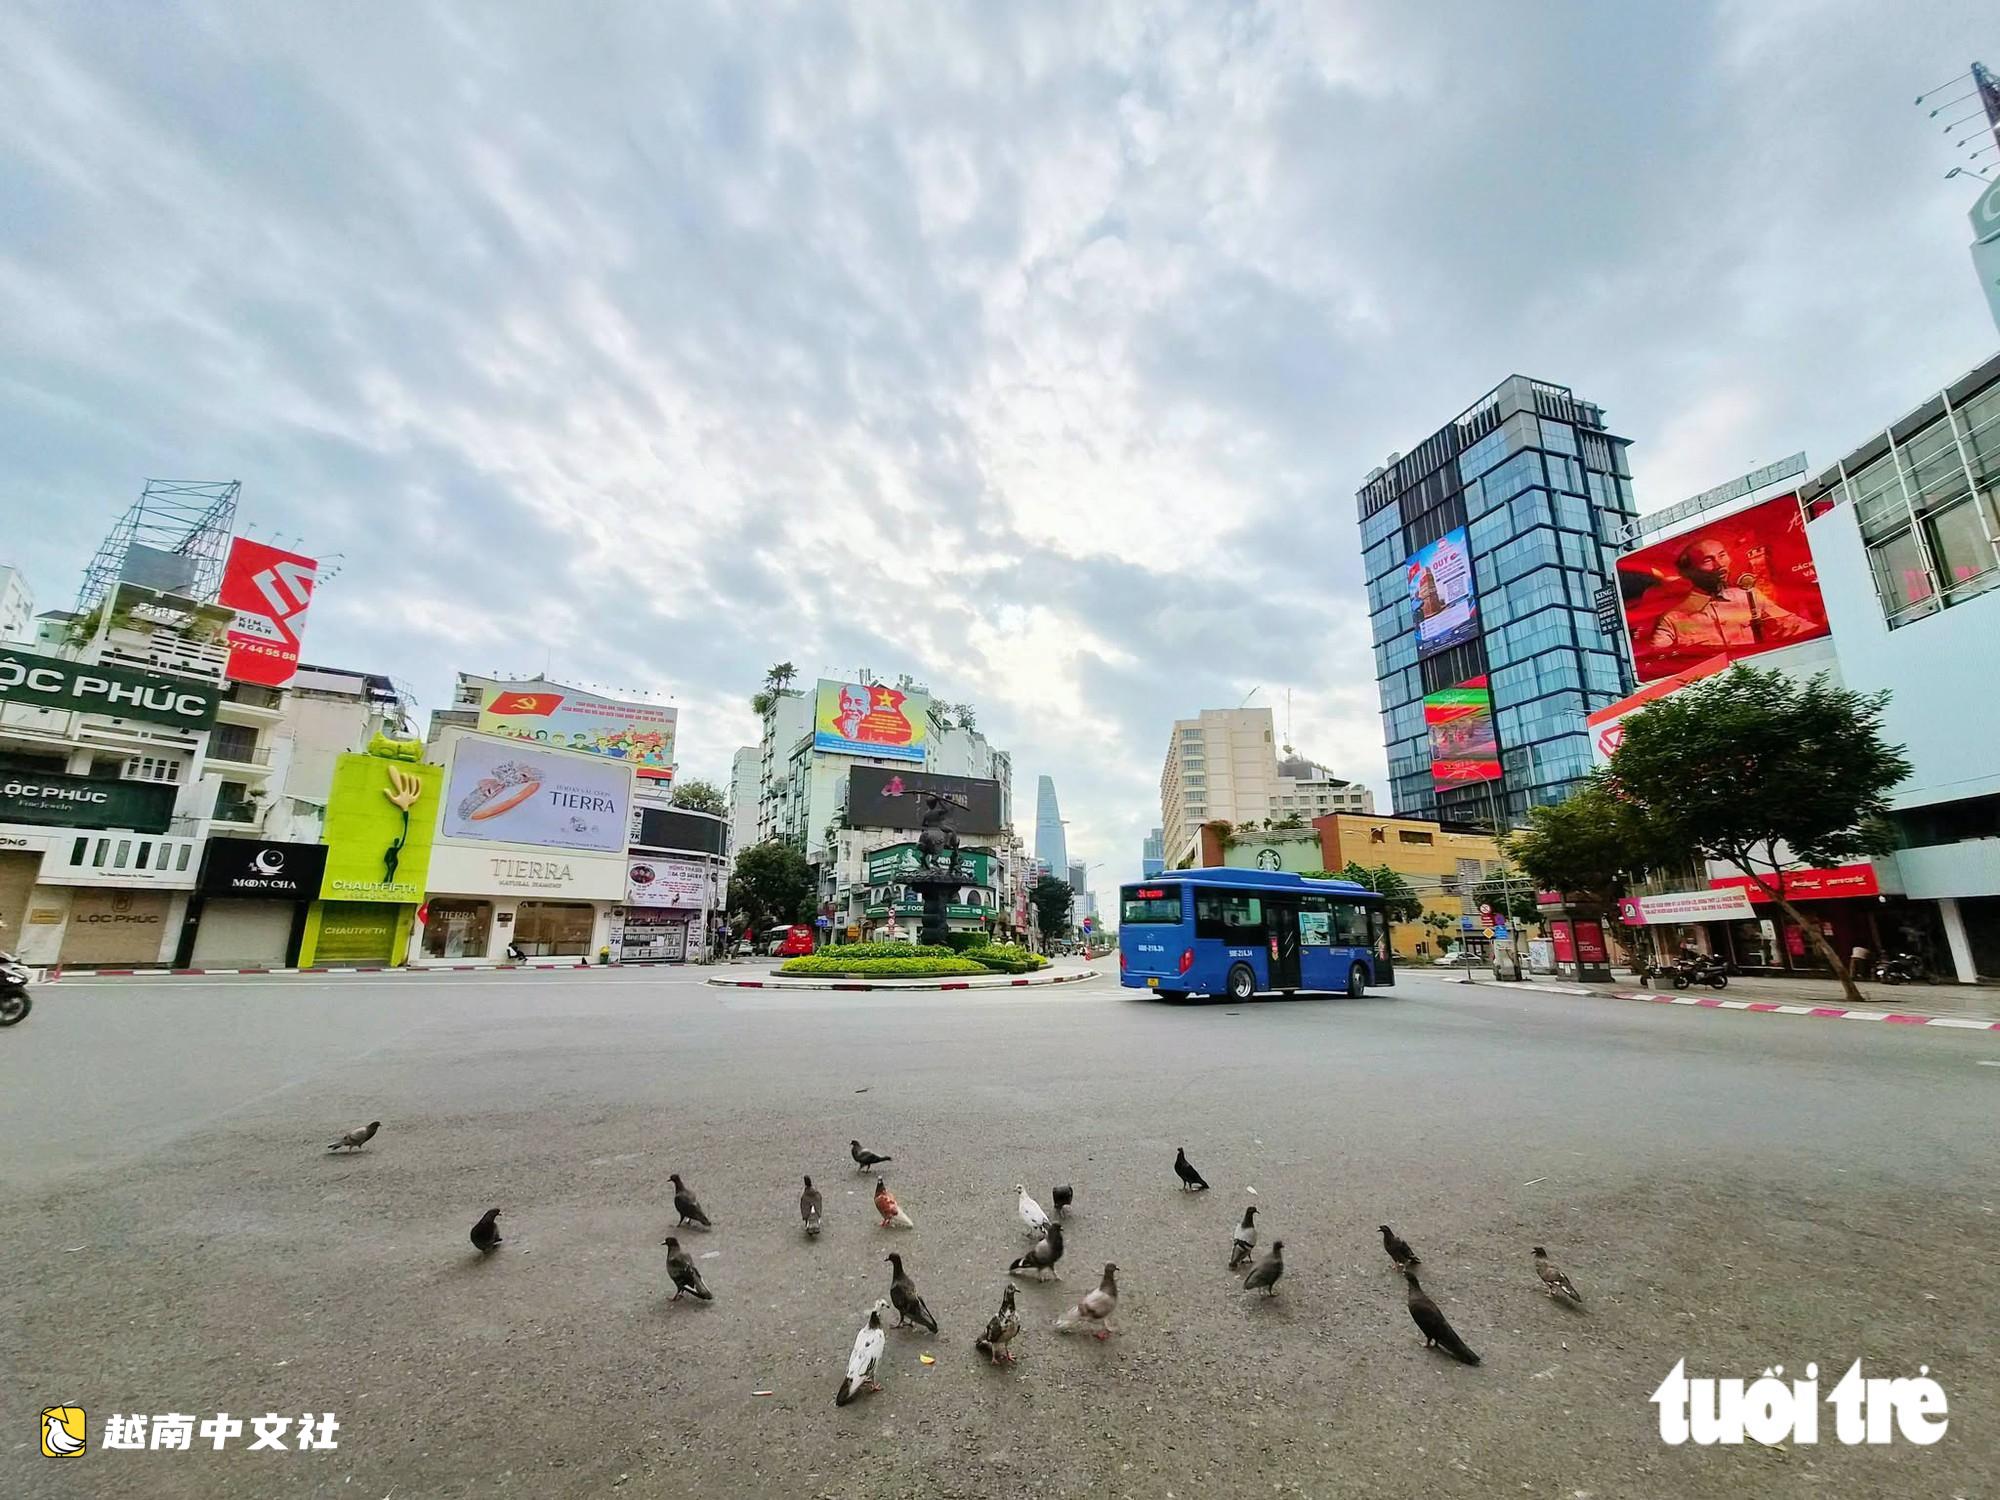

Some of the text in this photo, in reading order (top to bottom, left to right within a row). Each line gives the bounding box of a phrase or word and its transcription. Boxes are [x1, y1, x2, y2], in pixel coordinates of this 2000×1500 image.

[281, 651, 297, 662] 88
[72, 675, 207, 716] PHÚC
[0, 780, 108, 803] ỘC PHÚC
[549, 791, 615, 813] TIERRA
[489, 858, 574, 881] TIERRA
[232, 878, 297, 890] MOON CHA
[332, 880, 417, 893] CHAUTFIFTH
[439, 911, 477, 920] TIERRA
[325, 927, 386, 935] CHAUTFIFTH
